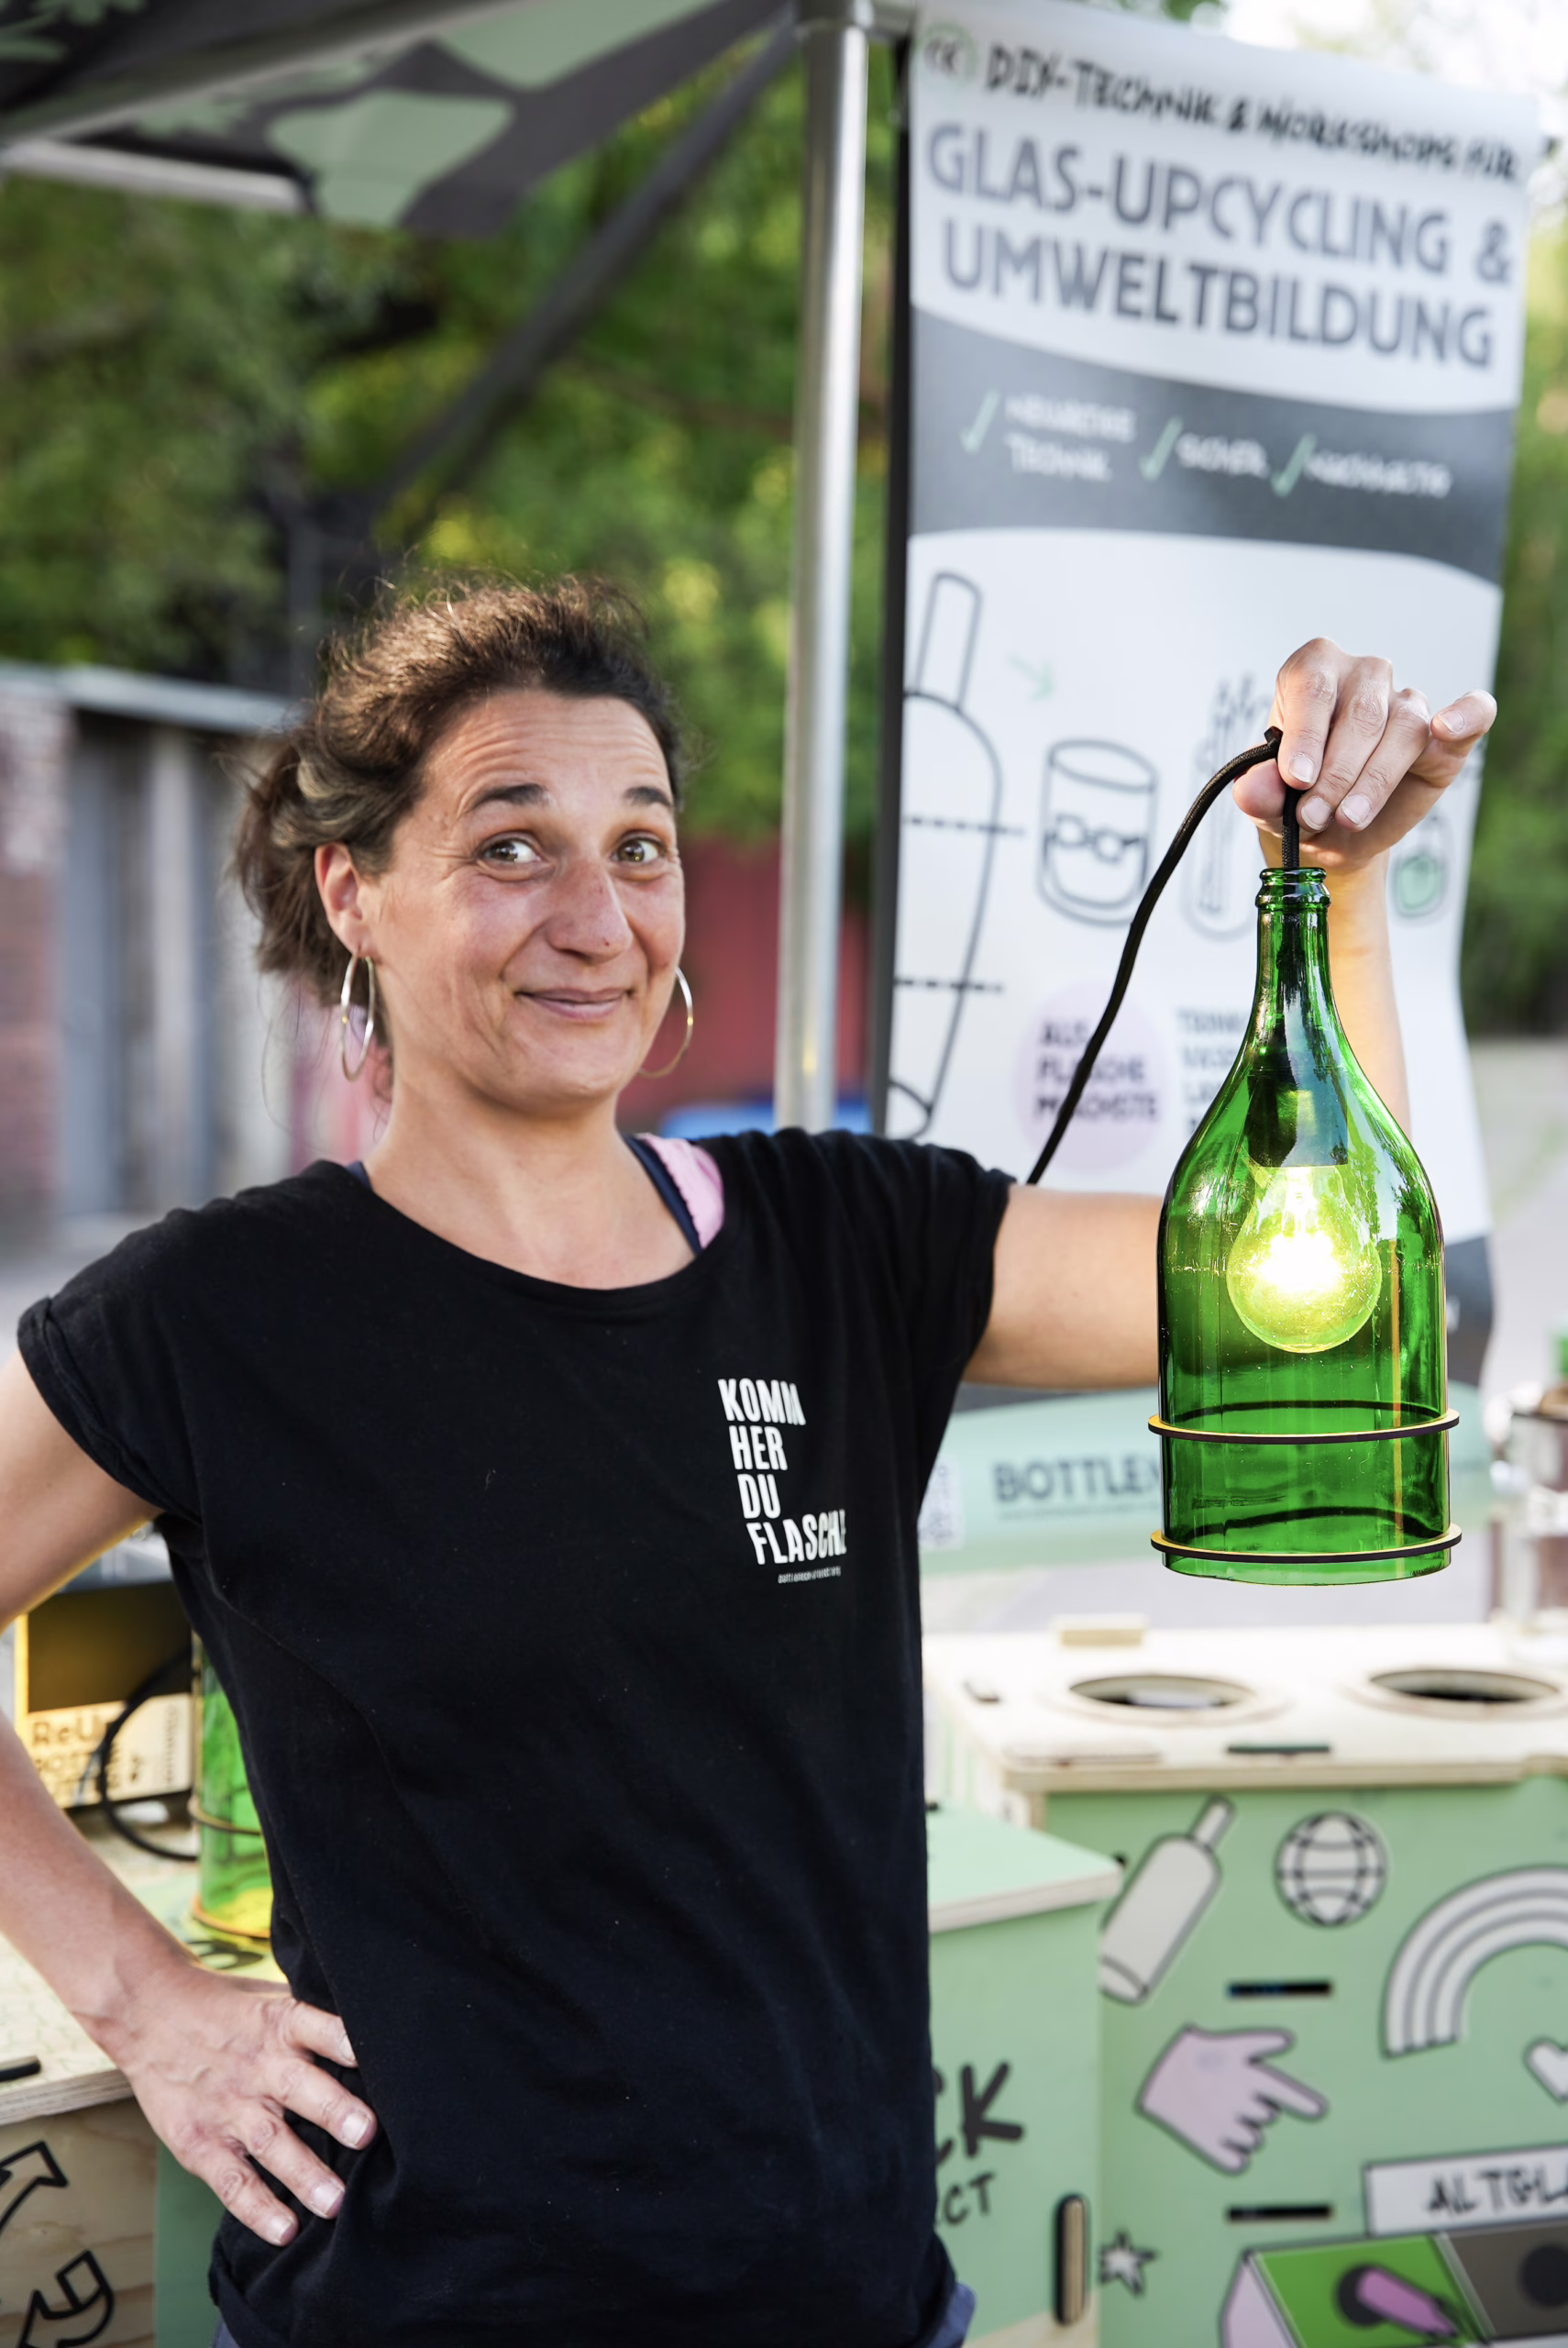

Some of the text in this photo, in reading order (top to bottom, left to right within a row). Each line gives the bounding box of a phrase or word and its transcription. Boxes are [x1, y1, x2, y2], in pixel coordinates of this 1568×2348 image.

[927, 121, 1513, 285] GLAS-UPCYCLING &
[942, 217, 1494, 370] UMWELTBILDUNG
[718, 1378, 806, 1426] KOMM
[729, 1425, 789, 1471] HER
[737, 1473, 781, 1520] DU
[994, 1452, 1161, 1501] BOTTLE
[1427, 2162, 1568, 2217] ALTGL
